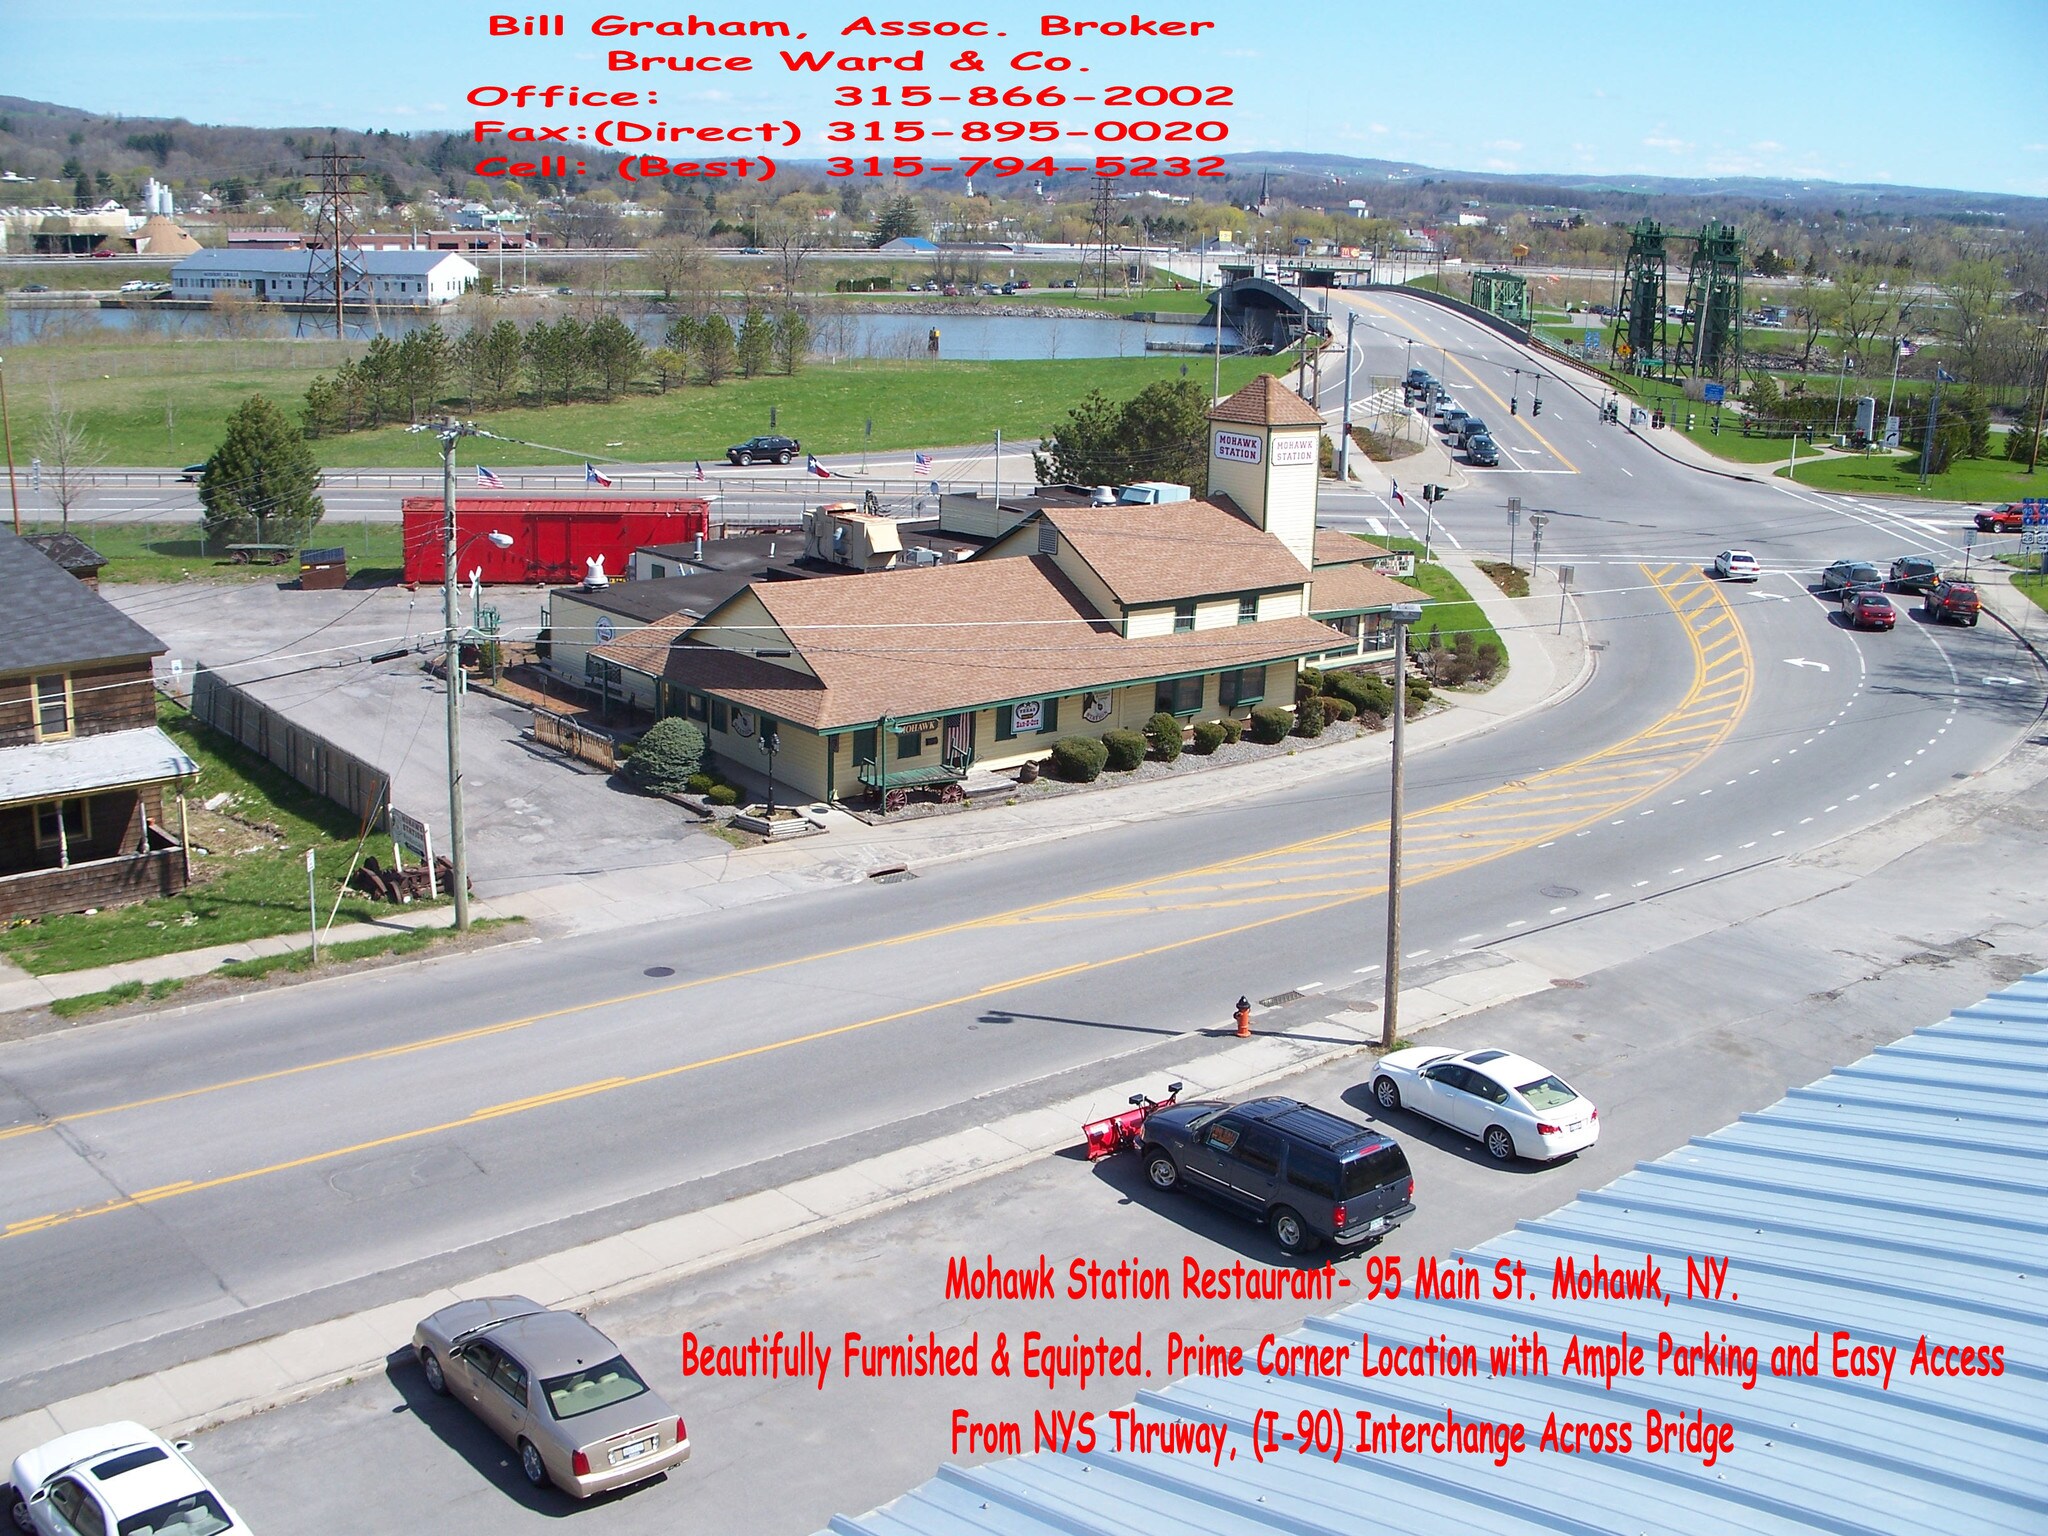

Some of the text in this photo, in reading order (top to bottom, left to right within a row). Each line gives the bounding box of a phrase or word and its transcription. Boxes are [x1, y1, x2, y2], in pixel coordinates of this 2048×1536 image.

[1219, 434, 1257, 449] MOHAWK
[1276, 440, 1313, 450] MOHAWK
[1219, 445, 1257, 459] STATION
[1276, 451, 1313, 461] STATION
[2023, 534, 2033, 542] 28
